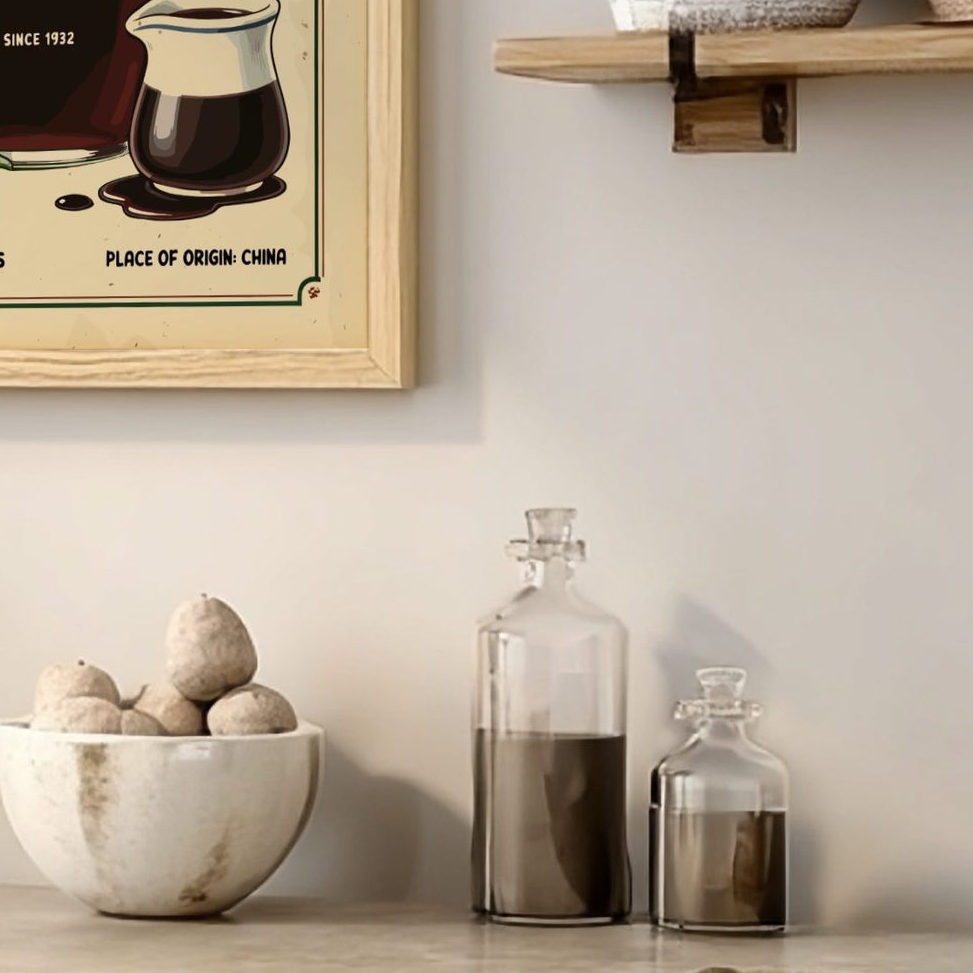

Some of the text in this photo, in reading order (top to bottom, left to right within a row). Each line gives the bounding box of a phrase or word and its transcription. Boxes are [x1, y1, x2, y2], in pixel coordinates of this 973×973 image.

[3, 31, 75, 47] SINCE 1932
[105, 247, 287, 268] PLACE OF ORIGIN: CHINA
